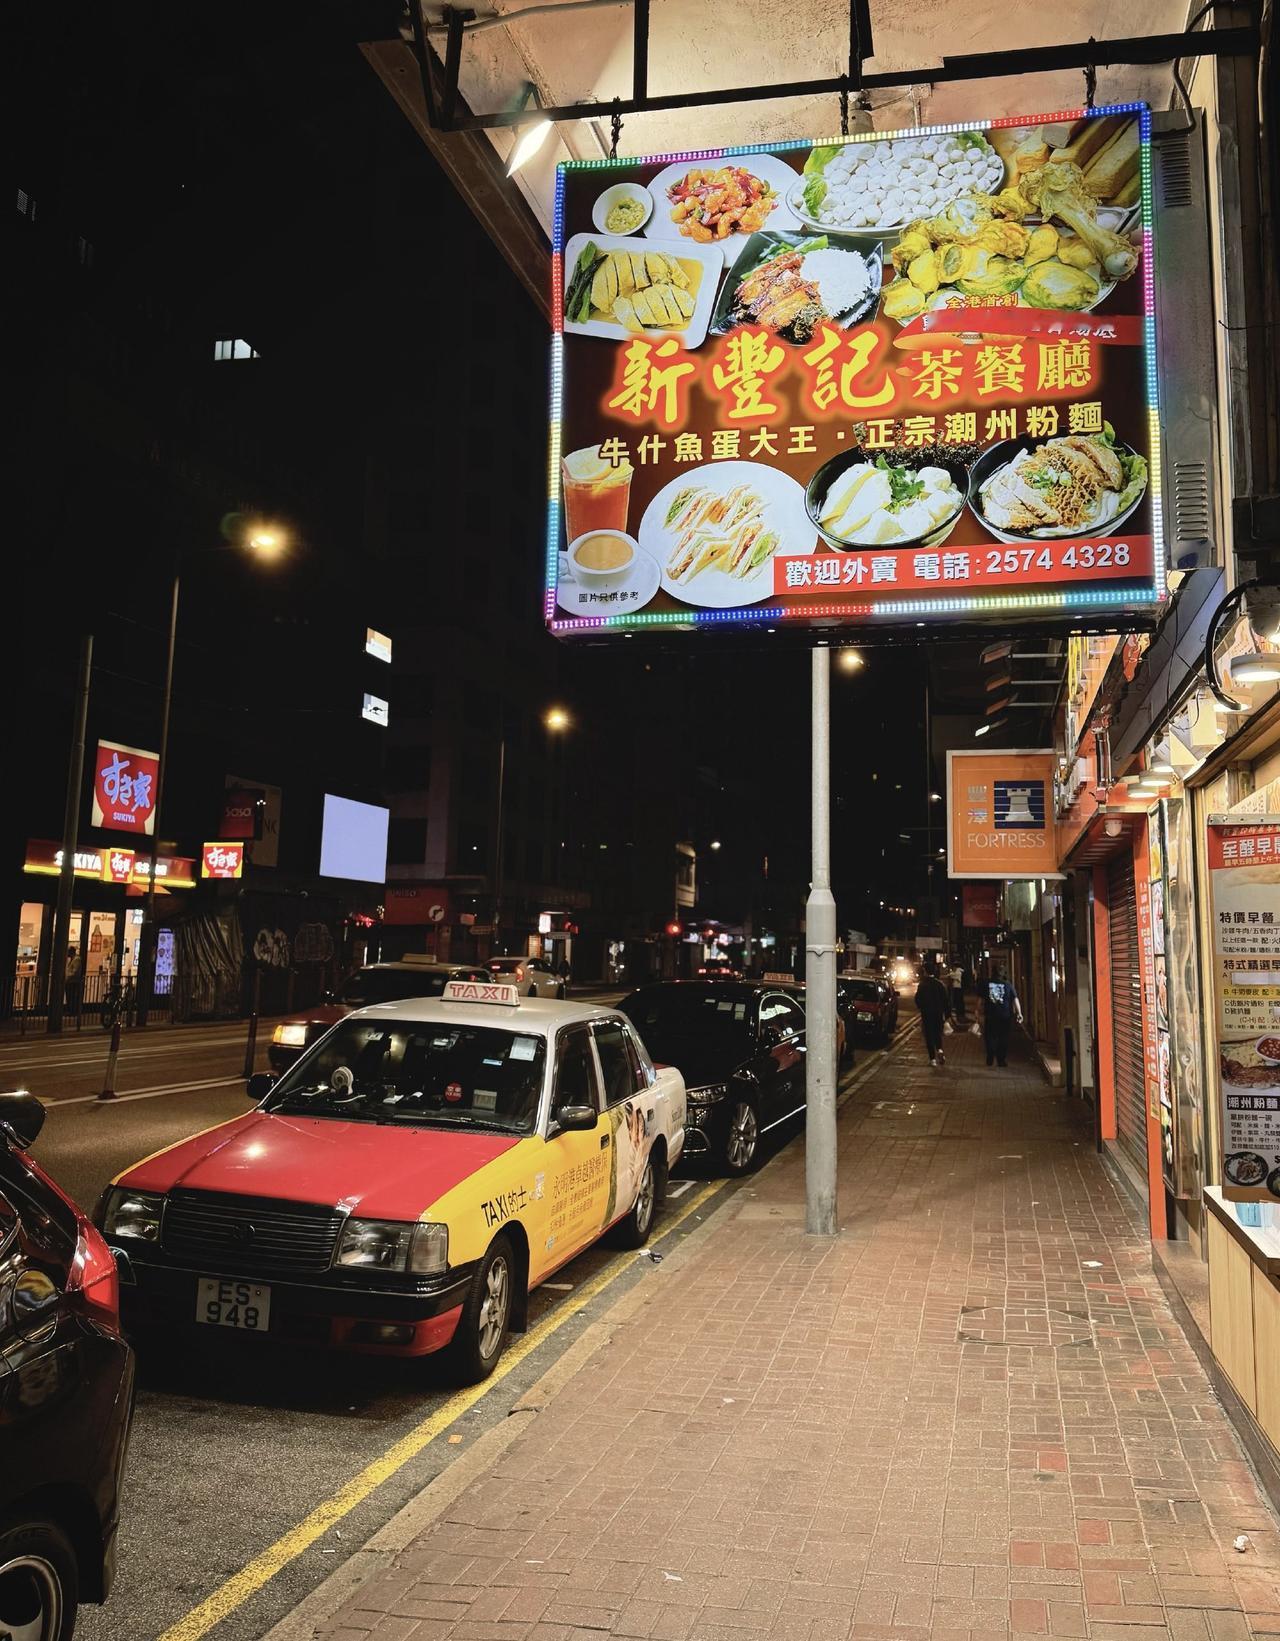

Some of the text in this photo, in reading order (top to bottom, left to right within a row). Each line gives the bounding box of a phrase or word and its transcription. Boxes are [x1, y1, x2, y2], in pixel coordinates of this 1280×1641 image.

[946, 293, 1019, 309] 全港首創
[609, 326, 1094, 423] 新豐記 茶餐廳
[599, 401, 1104, 467] 牛什魚蛋大王 正宗潮州粉麵
[785, 553, 899, 588] 歡迎外賣
[986, 547, 1055, 575] 2574
[1061, 543, 1131, 570] 4328
[100, 752, 153, 813] すき家
[112, 812, 136, 824] SUKIYA
[967, 832, 1046, 849] FORTRESS
[53, 850, 101, 872] SKIYA
[1220, 911, 1274, 923] 特價早餐
[450, 983, 509, 1001] TAXI
[218, 1281, 251, 1306] ES
[206, 1301, 259, 1328] 948
